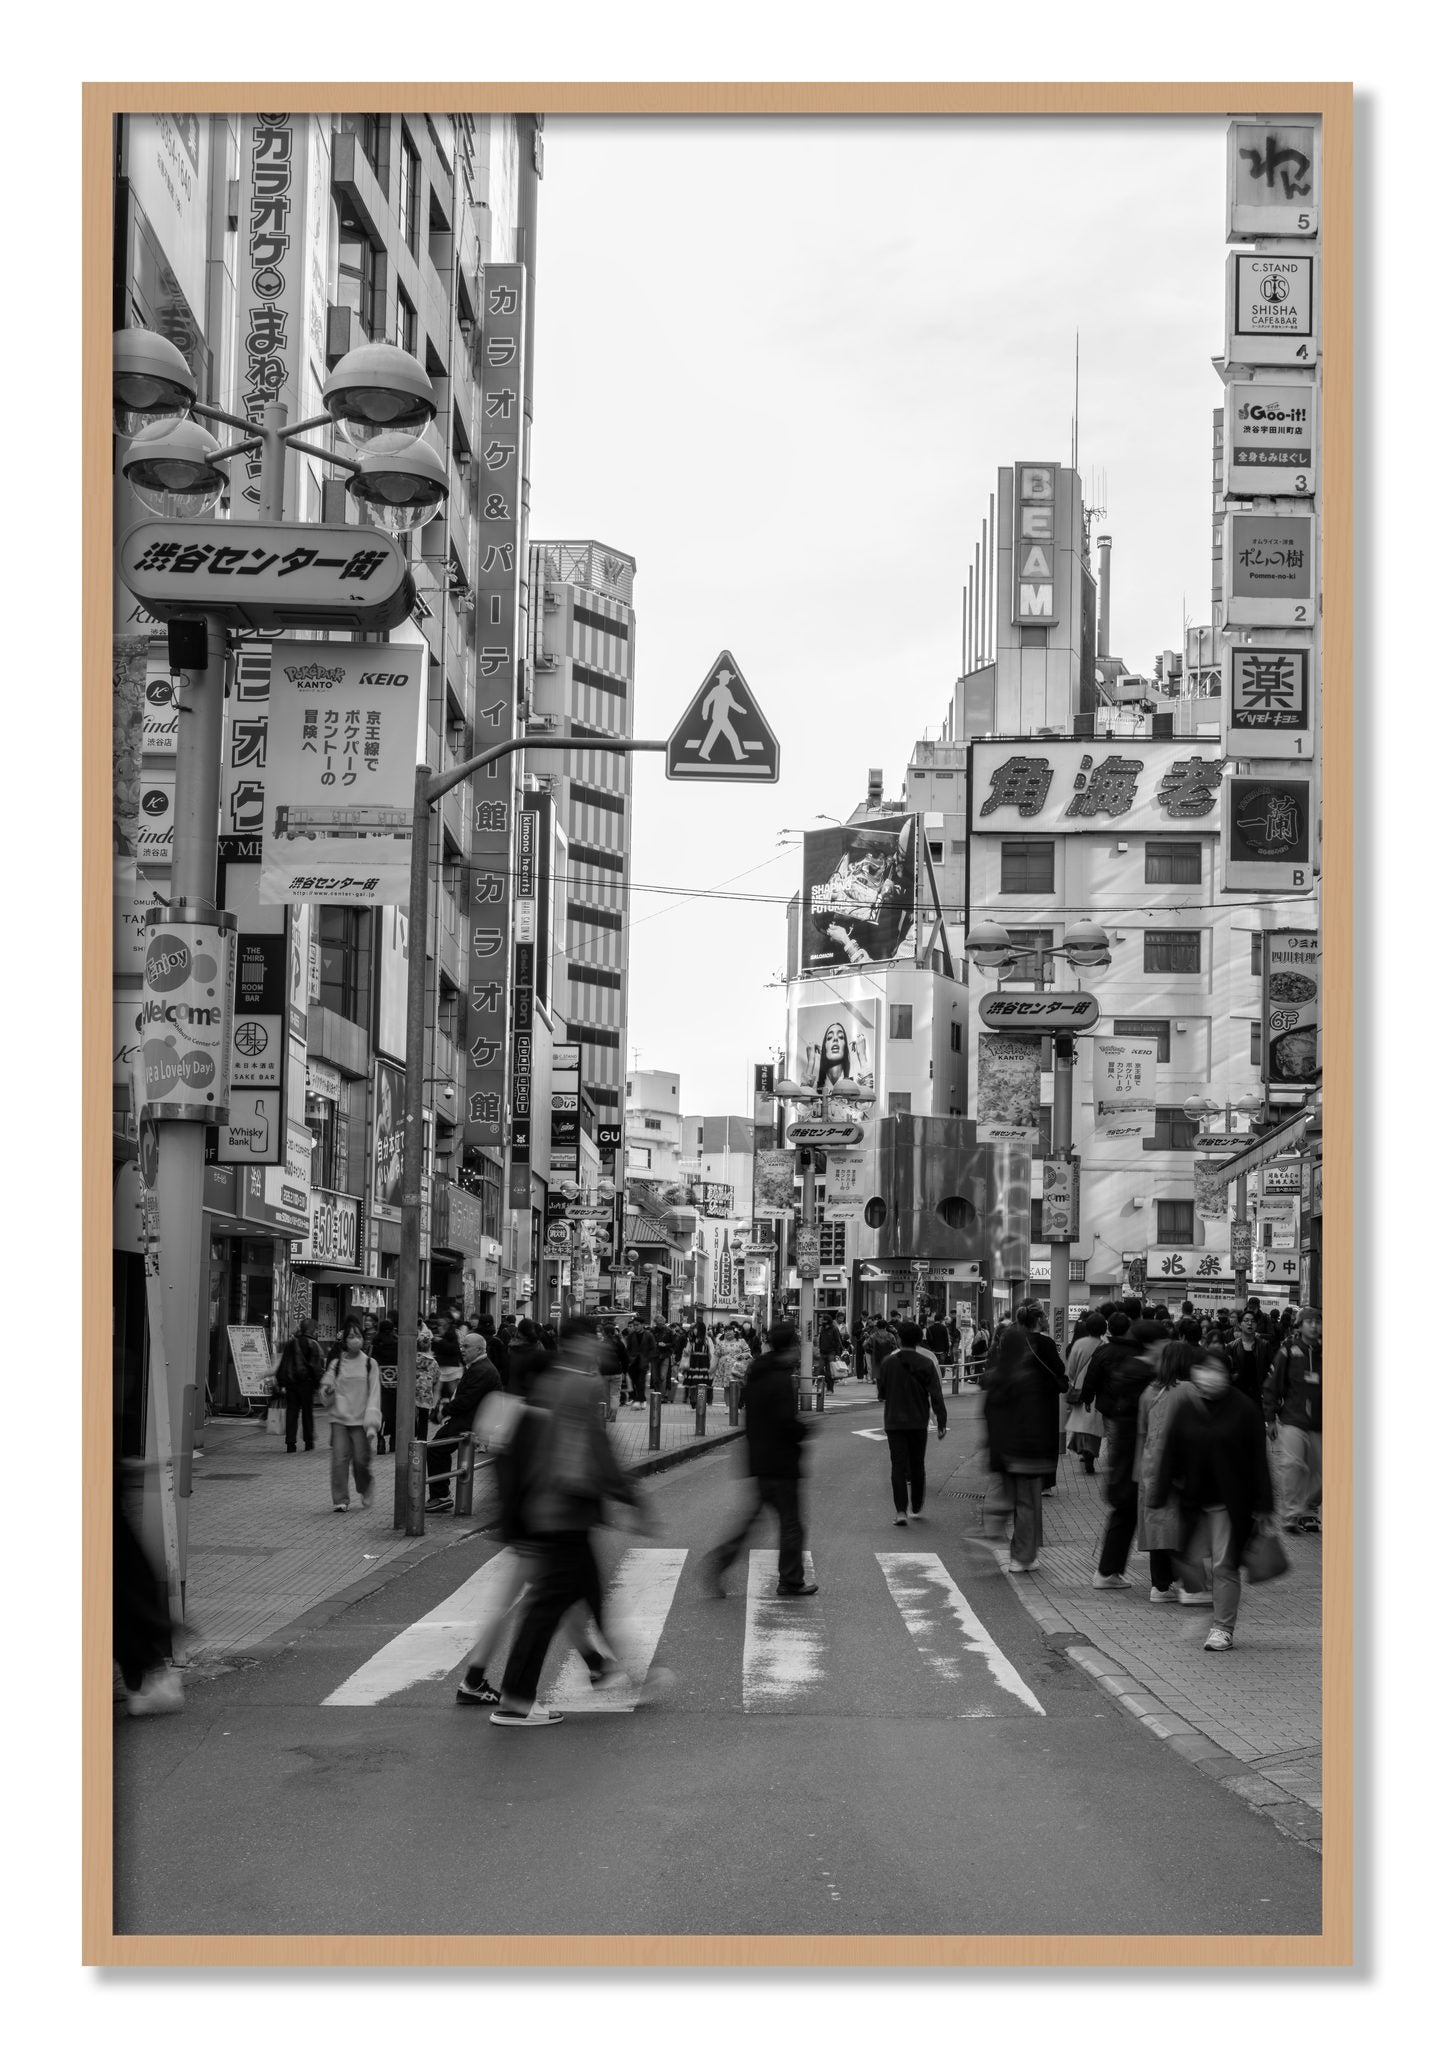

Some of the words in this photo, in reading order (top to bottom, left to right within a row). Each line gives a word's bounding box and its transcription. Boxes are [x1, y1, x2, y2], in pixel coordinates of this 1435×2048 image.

[250, 126, 293, 270] カラオケ
[1298, 214, 1310, 229] 5
[1252, 263, 1298, 273] C.STAND
[1252, 305, 1298, 316] SHISHA
[1252, 316, 1298, 325] CAFE&BAR
[1296, 344, 1308, 360] 4
[1250, 405, 1306, 421] Goo-it!
[1243, 425, 1303, 435] 渋谷宇田川町店
[1238, 451, 1308, 464] 全身もみほぐし
[1295, 475, 1307, 492] 3
[1021, 468, 1054, 616] BEAM
[133, 541, 389, 582] 渋谷センター街
[1239, 548, 1304, 568] ポムの樹
[1250, 572, 1296, 580] Pomme-no-ki
[1294, 606, 1306, 622] 2
[297, 681, 333, 689] KANTO
[358, 672, 409, 687] KEIO
[1242, 656, 1294, 708] 薬
[1236, 711, 1299, 727] マツモトキヨシ
[301, 709, 318, 753] 冒険へ
[147, 738, 172, 747] 渋谷店
[320, 709, 339, 786] カントーの
[341, 709, 360, 786] ポケパーク
[364, 711, 381, 771] 京王線で
[1294, 738, 1302, 753] 1
[979, 755, 1225, 817] 角海老
[522, 816, 530, 852] kimono
[143, 848, 168, 857] 渋谷店
[288, 876, 380, 891] 渋谷センター街
[522, 858, 530, 893] hearts
[1293, 870, 1304, 886] B
[242, 953, 265, 961] THIRD
[1271, 951, 1316, 964] 四川料理
[146, 949, 188, 984] Enjoy
[241, 983, 264, 991] ROOM
[468, 874, 505, 1123] カラオケ館
[142, 999, 222, 1025] Welcome
[987, 1001, 1093, 1016] 渋谷センター街
[1269, 1010, 1299, 1030] 6F
[153, 1065, 159, 1081] a
[160, 1059, 191, 1080] Lovely
[193, 1061, 214, 1075] Day!
[1115, 1062, 1124, 1092] カントーの
[564, 1101, 576, 1109] UP
[229, 1128, 263, 1139] Whisky
[600, 1131, 620, 1142] GU
[790, 1128, 854, 1137] 渋谷センター街
[229, 1137, 249, 1145] Bank
[1162, 1254, 1222, 1275] 兆楽
[721, 1252, 731, 1296] BEER
[719, 1297, 731, 1305] HALL
